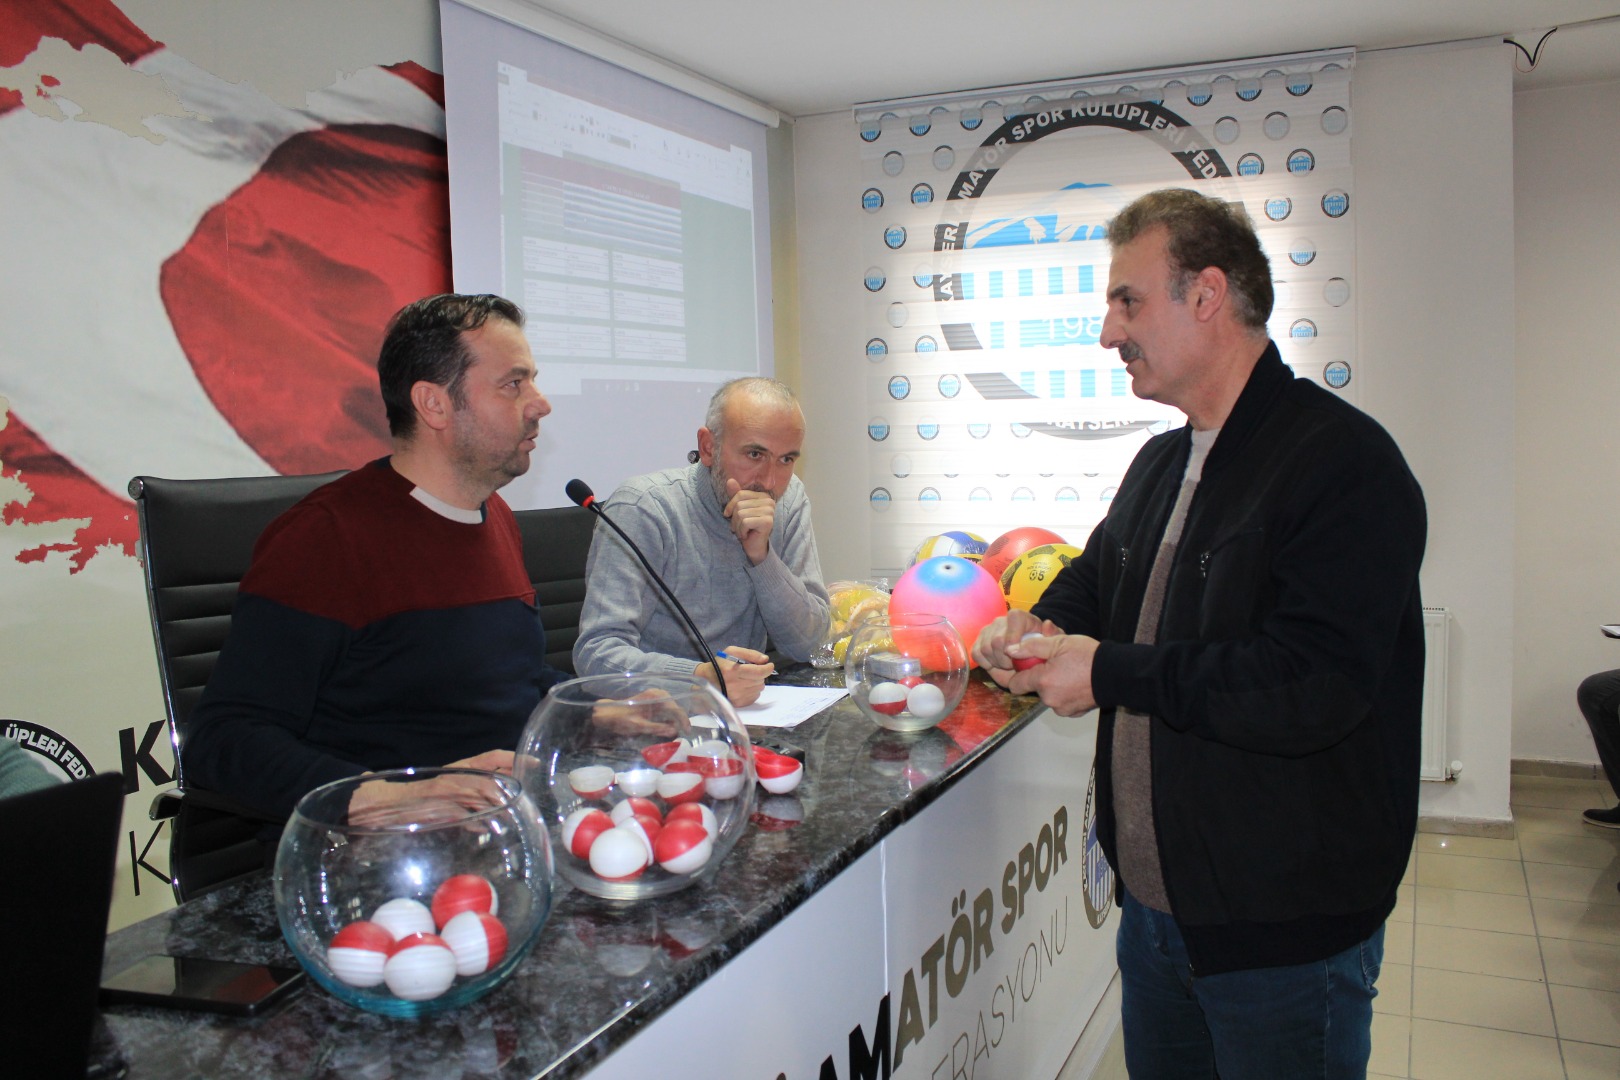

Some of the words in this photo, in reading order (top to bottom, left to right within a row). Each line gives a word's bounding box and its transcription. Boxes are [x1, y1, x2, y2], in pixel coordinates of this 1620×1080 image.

[1010, 106, 1066, 142] SPOR
[1042, 316, 1104, 340] 198
[60, 751, 92, 780] FED
[1001, 805, 1068, 935] SPOR
